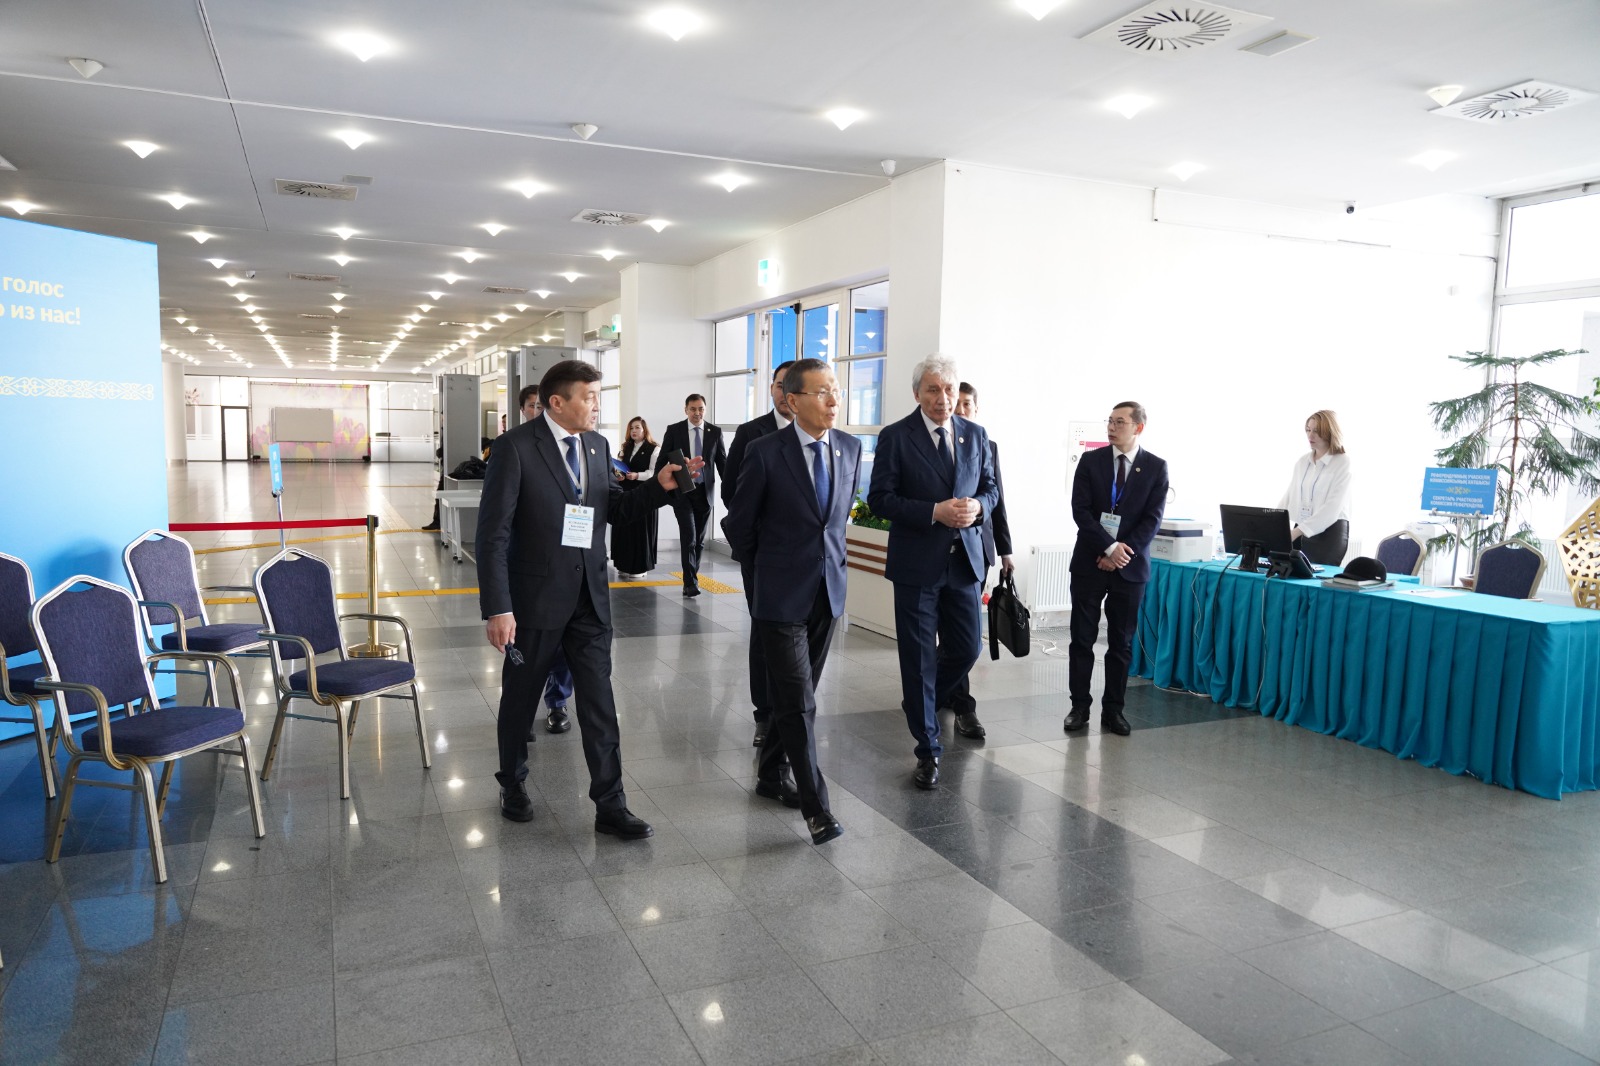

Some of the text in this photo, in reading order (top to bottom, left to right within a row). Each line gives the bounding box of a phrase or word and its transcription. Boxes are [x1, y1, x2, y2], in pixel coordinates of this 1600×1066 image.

[2, 276, 65, 298] голос
[10, 304, 35, 321] из
[40, 306, 81, 326] нас!
